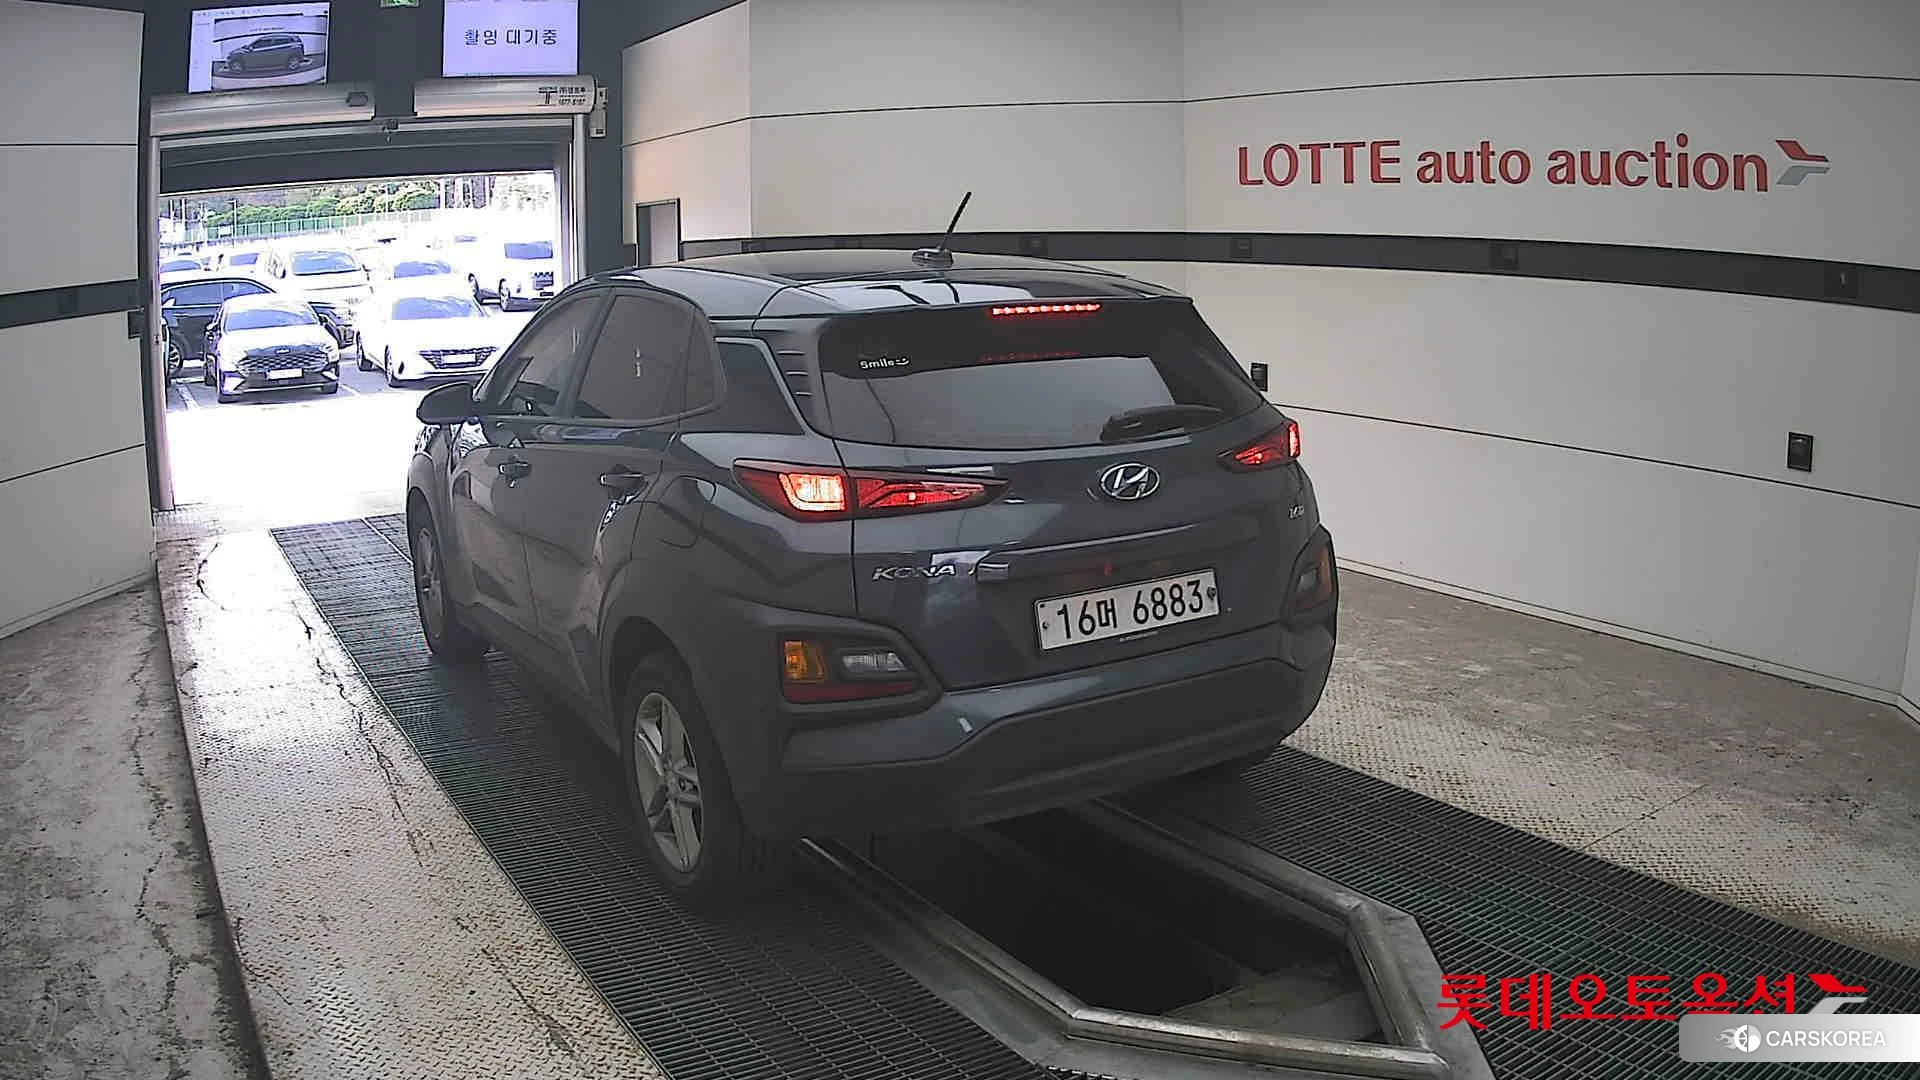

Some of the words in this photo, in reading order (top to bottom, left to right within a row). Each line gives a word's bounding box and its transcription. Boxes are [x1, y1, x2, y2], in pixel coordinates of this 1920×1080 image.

[506, 28, 558, 46] 대기중
[1238, 139, 1401, 187] LOTTE
[1416, 140, 1532, 185] auto
[1547, 132, 1769, 193] auction
[872, 564, 956, 581] KONA
[1057, 597, 1118, 640] 16머
[1132, 579, 1204, 625] 6883
